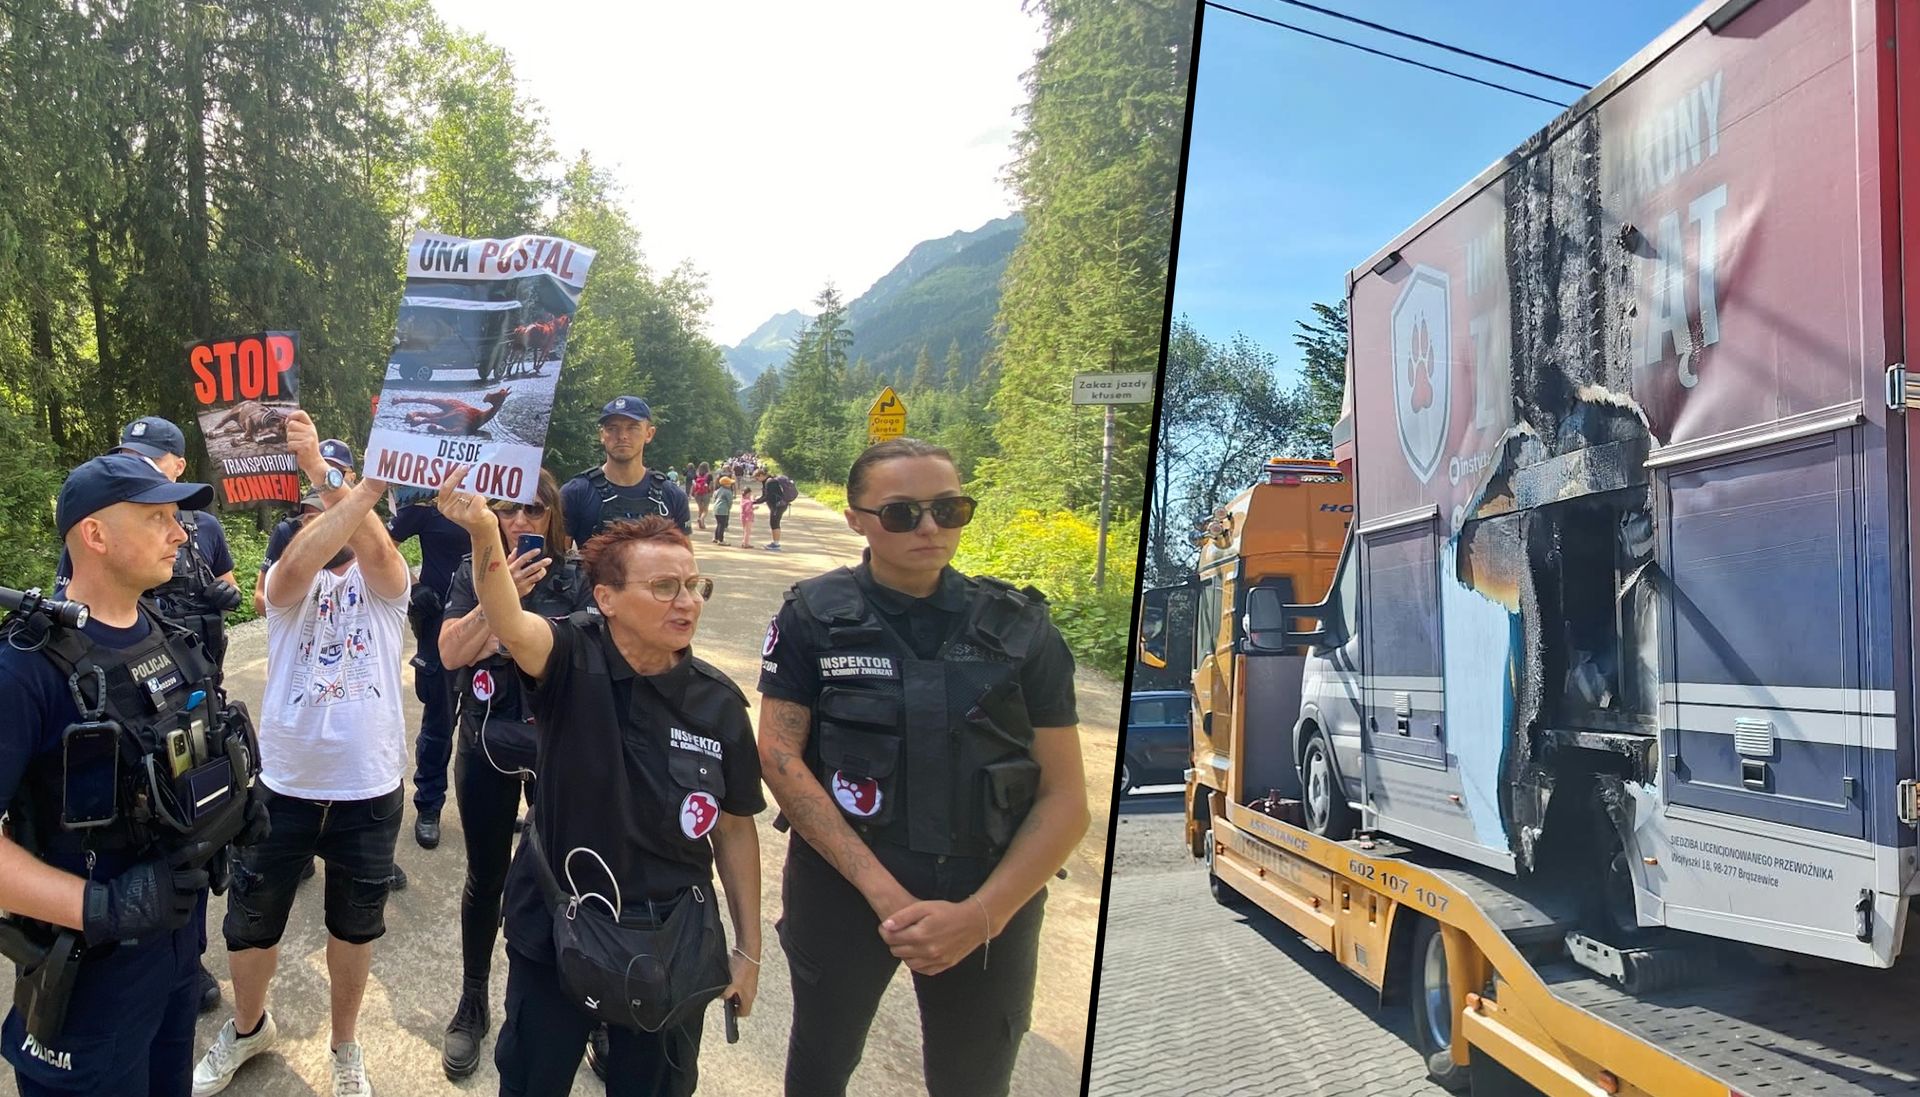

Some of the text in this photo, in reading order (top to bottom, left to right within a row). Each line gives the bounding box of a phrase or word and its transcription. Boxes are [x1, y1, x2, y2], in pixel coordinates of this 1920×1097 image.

[419, 237, 577, 280] UNA POSTAL
[190, 335, 295, 405] STOP
[1079, 379, 1147, 390] Zakaz jazdy
[874, 417, 900, 426] Droga
[437, 439, 483, 463] DESDE
[376, 448, 524, 499] MORSKE OKO
[131, 653, 172, 682] POLICJA
[819, 655, 892, 669] INSPEKTOR
[831, 668, 860, 677] OCHRONY
[670, 727, 723, 754] INSPEKTO
[1670, 835, 1834, 881] SIEDZIBA LICENCJONOWANEGO PRZEWOŹNIKA
[1713, 862, 1737, 878] 98-277
[1349, 859, 1449, 912] 602 107 107
[21, 1033, 72, 1071] POLICJA
